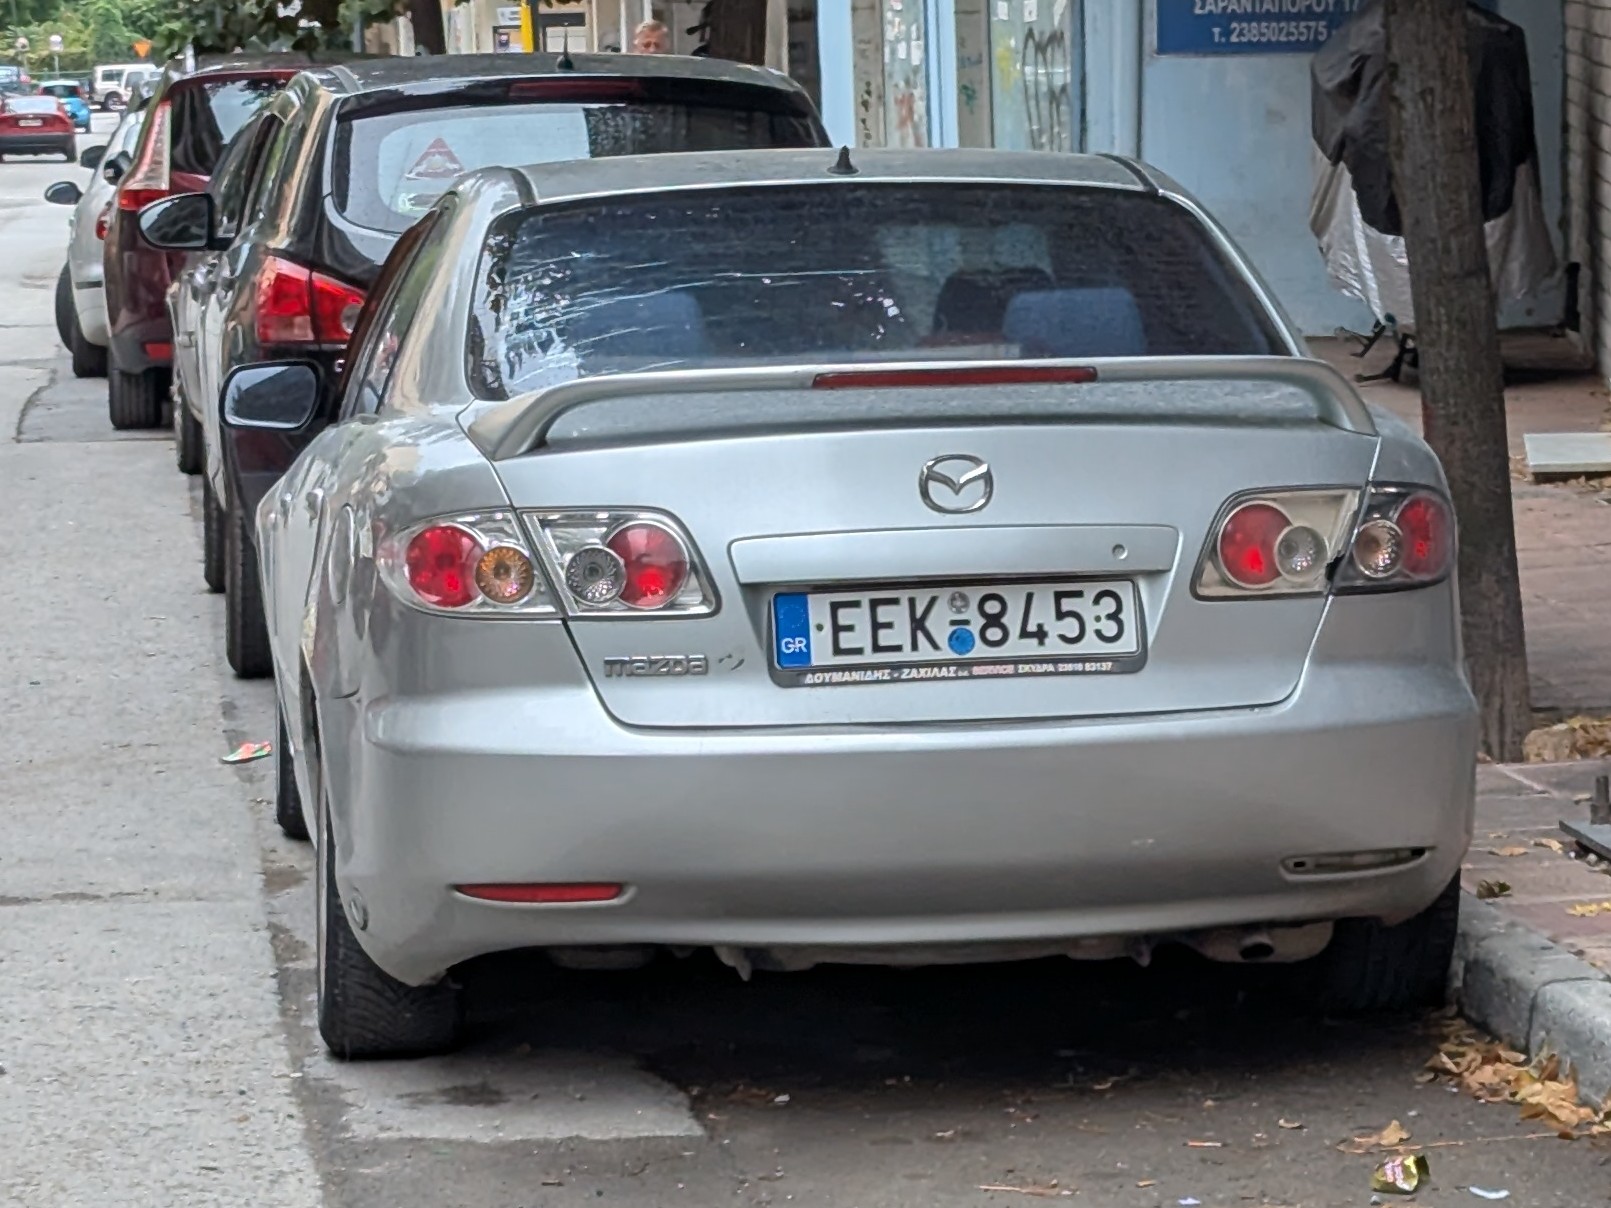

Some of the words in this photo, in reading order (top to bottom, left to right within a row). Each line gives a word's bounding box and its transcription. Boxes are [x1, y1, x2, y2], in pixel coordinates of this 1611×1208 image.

[1229, 21, 1328, 43] 2385025575
[781, 637, 808, 654] GR
[603, 655, 709, 677] mazda
[804, 669, 892, 684] ΔΟΥΜΑΝΙΔΗΣ
[901, 666, 957, 680] ΖΑΧΙΛΑΣ
